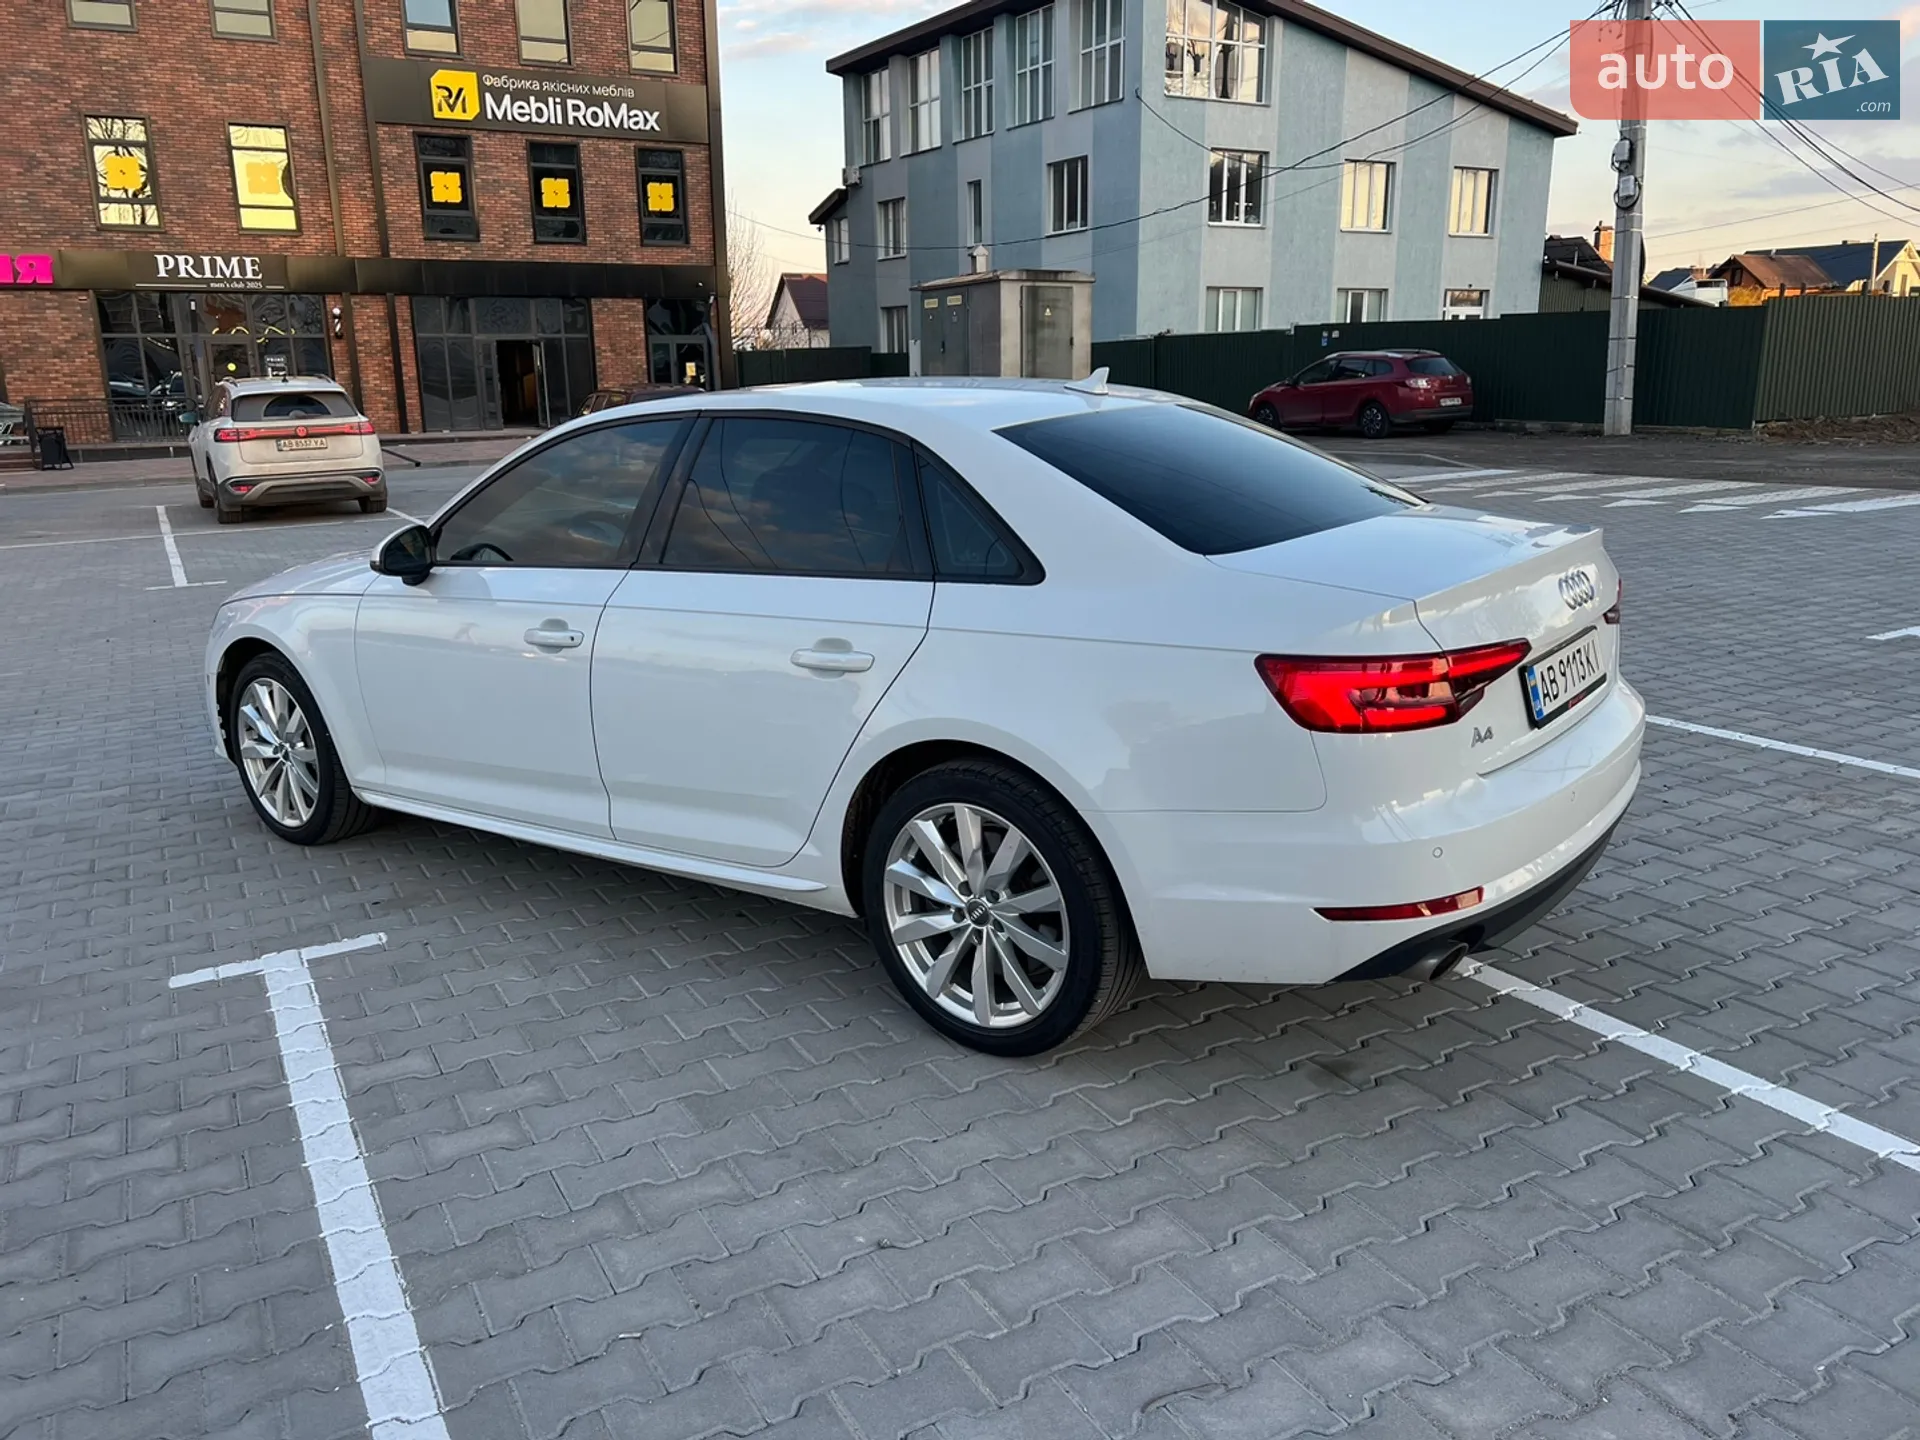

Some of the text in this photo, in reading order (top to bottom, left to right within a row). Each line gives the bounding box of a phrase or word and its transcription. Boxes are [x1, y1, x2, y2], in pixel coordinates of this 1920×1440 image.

[482, 74, 635, 99] Фабрика якісних меблів
[484, 92, 661, 131] Mebli RoMax
[154, 254, 263, 279] PRIME
[1540, 665, 1560, 706] AB
[1559, 648, 1586, 694] 9113
[1471, 726, 1494, 748] A4
